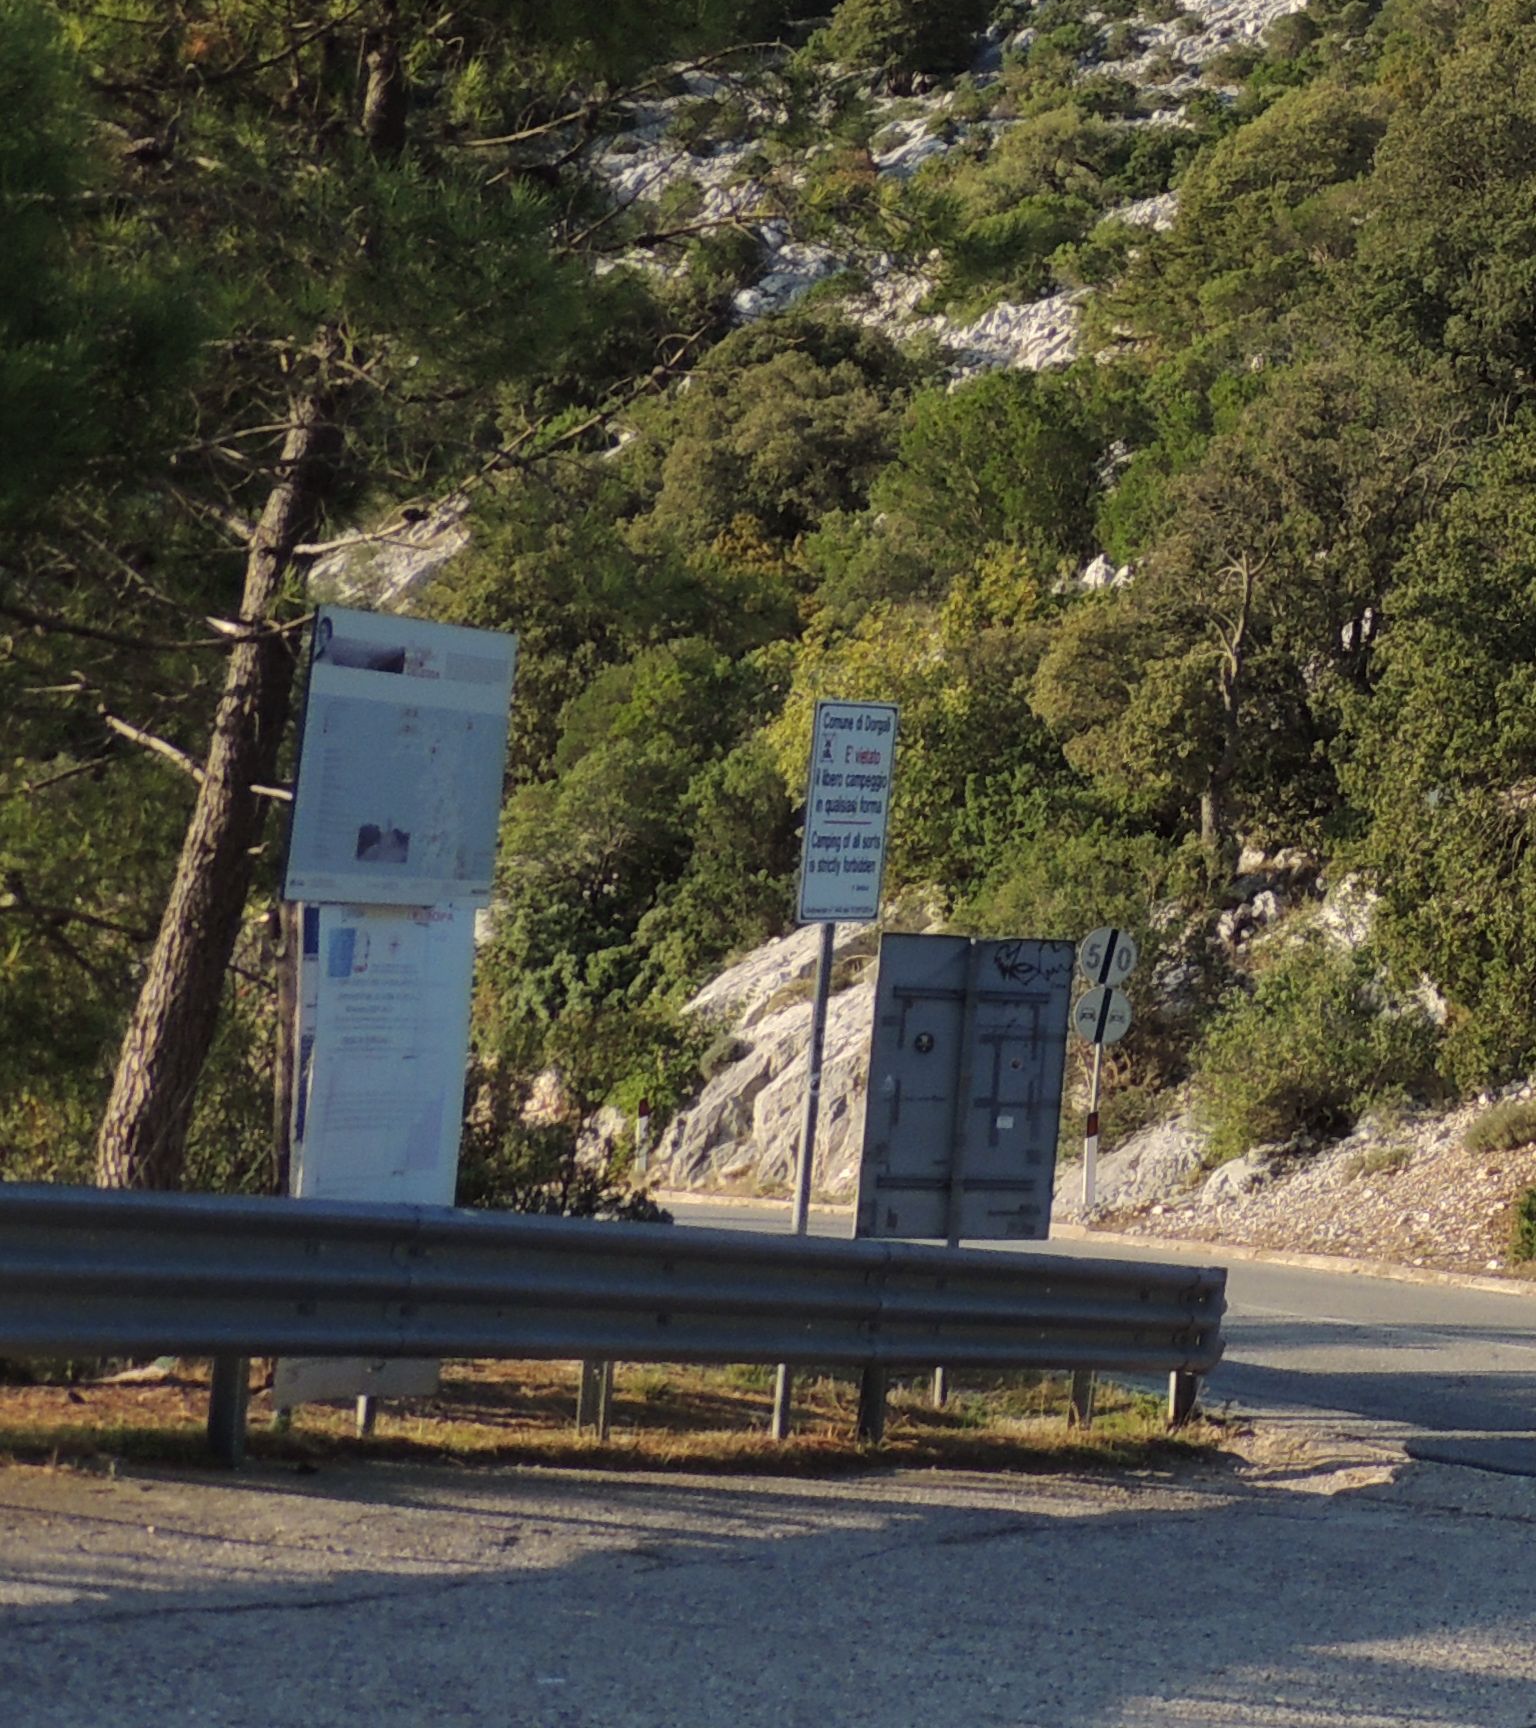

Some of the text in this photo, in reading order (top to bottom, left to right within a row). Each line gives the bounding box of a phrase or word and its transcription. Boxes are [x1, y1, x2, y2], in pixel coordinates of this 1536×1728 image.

[824, 712, 891, 735] Comune di Dorgali
[855, 747, 881, 764] vietato
[822, 768, 843, 787] libero
[845, 771, 887, 792] campeggio
[816, 795, 881, 816] in qualsiasi forma
[811, 831, 881, 852] Camping of all sorts
[809, 856, 876, 876] is strictly forbidden
[1086, 943, 1132, 971] 50
